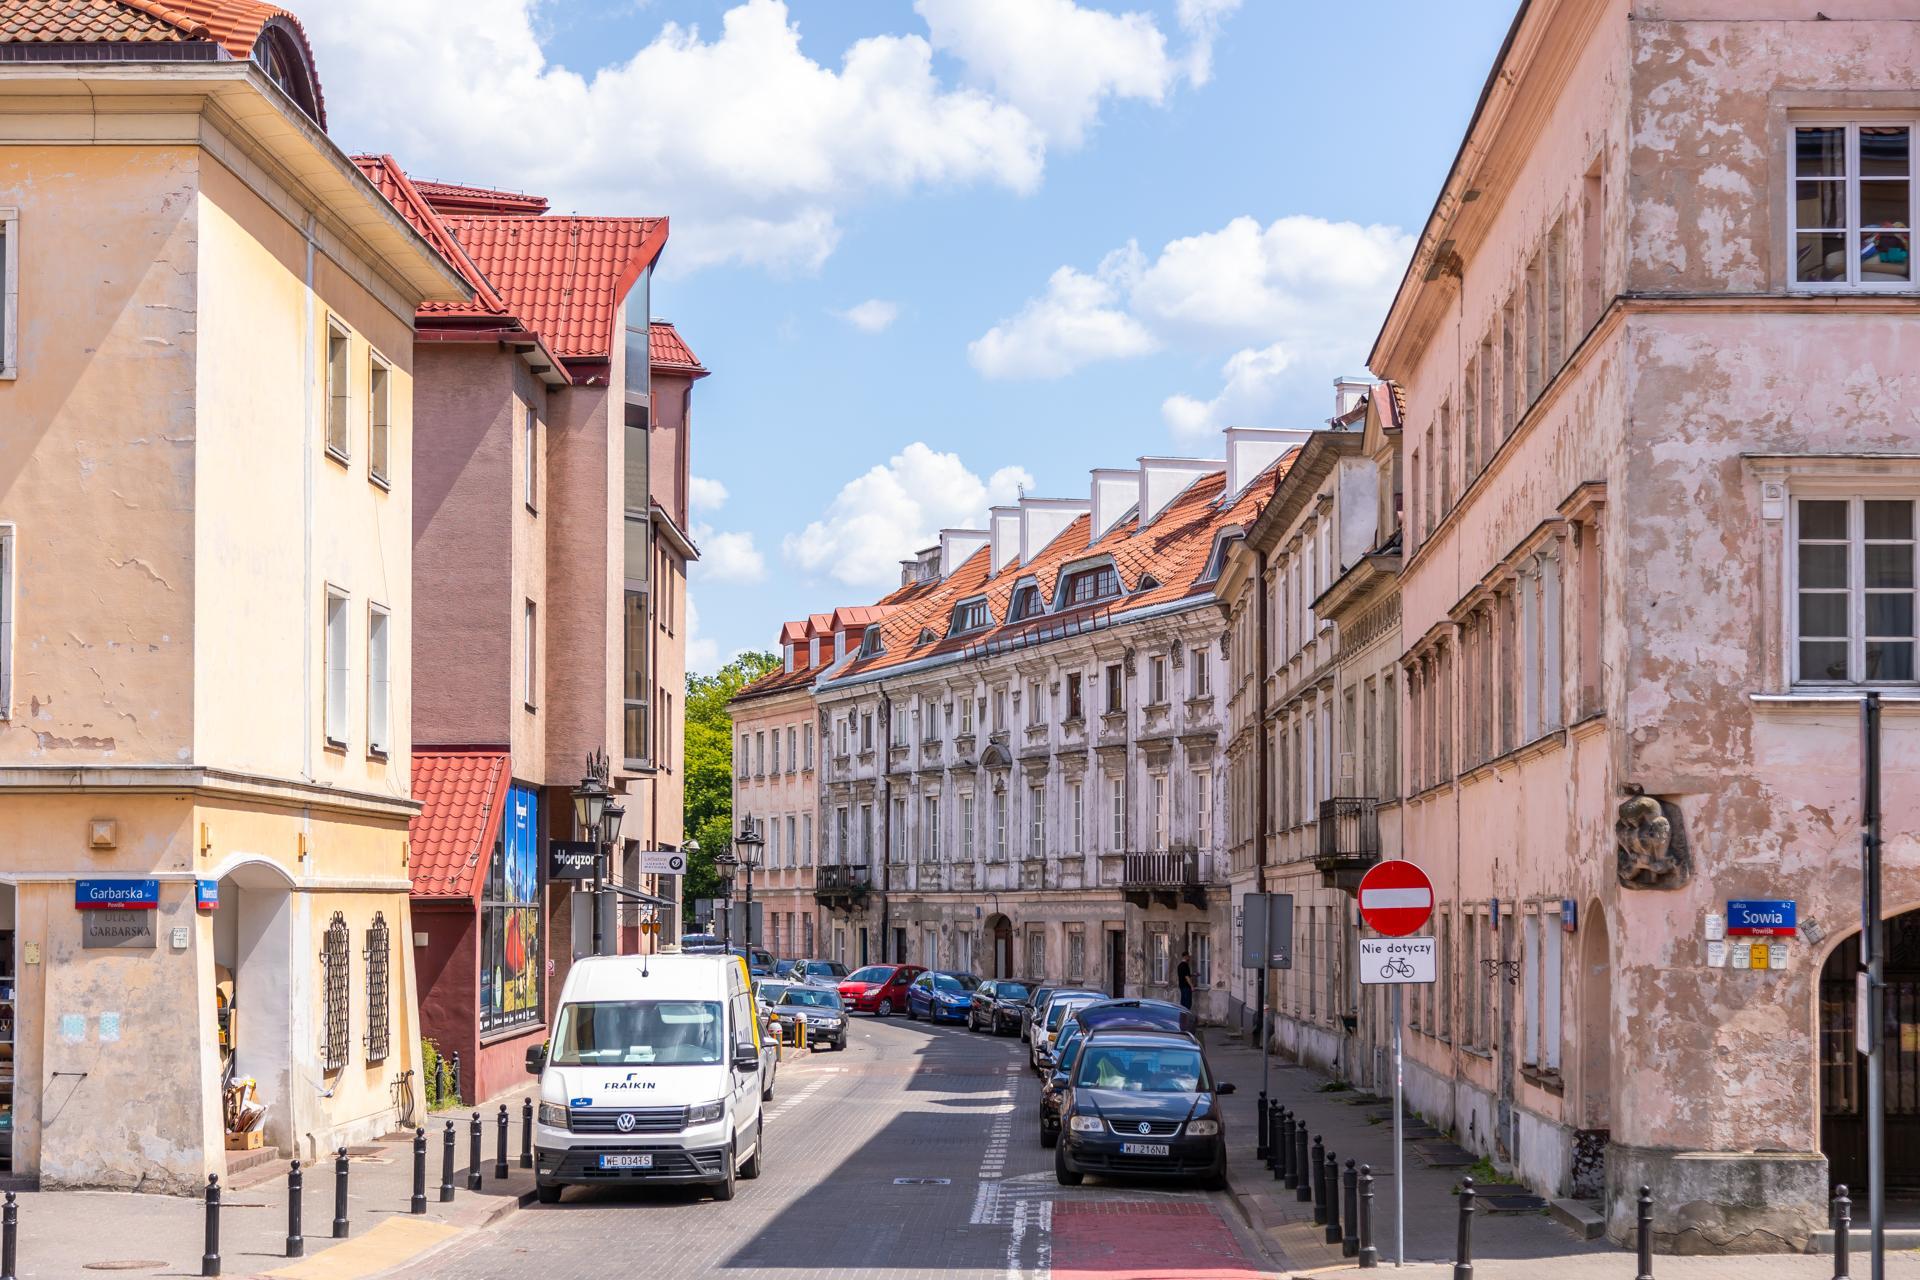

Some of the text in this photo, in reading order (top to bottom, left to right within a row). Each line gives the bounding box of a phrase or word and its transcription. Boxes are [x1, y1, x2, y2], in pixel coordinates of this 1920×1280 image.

[90, 887, 143, 899] Garbarska
[1742, 910, 1783, 924] Sowia
[90, 926, 151, 937] GARBARSKA
[1362, 943, 1431, 955] Nie dotyczy
[604, 1082, 656, 1090] FRAIKIN
[605, 1156, 618, 1166] WE
